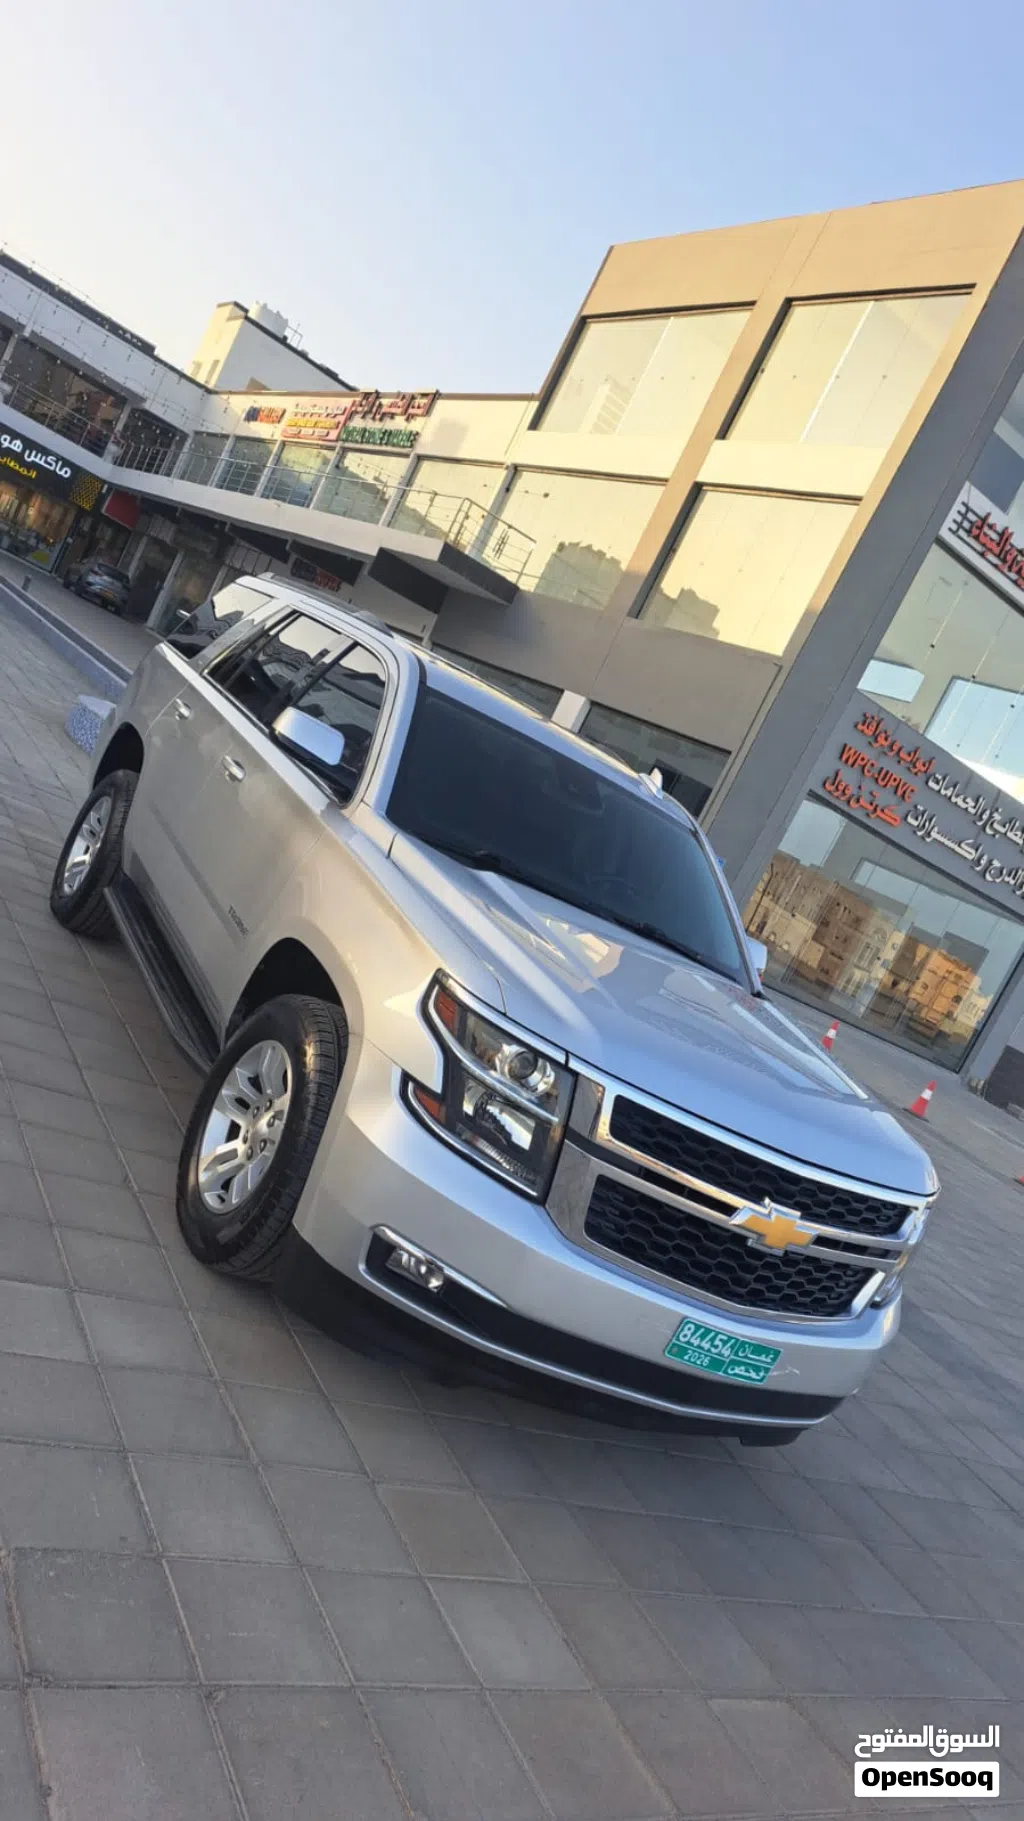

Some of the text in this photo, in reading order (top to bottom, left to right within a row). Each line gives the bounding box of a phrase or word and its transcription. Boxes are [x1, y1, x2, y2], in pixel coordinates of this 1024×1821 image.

[0, 434, 72, 478] ماكس هو
[0, 456, 37, 479] المطاب
[984, 807, 1024, 847] طابخ
[679, 1323, 737, 1357] 84454
[683, 1349, 711, 1367] 2026
